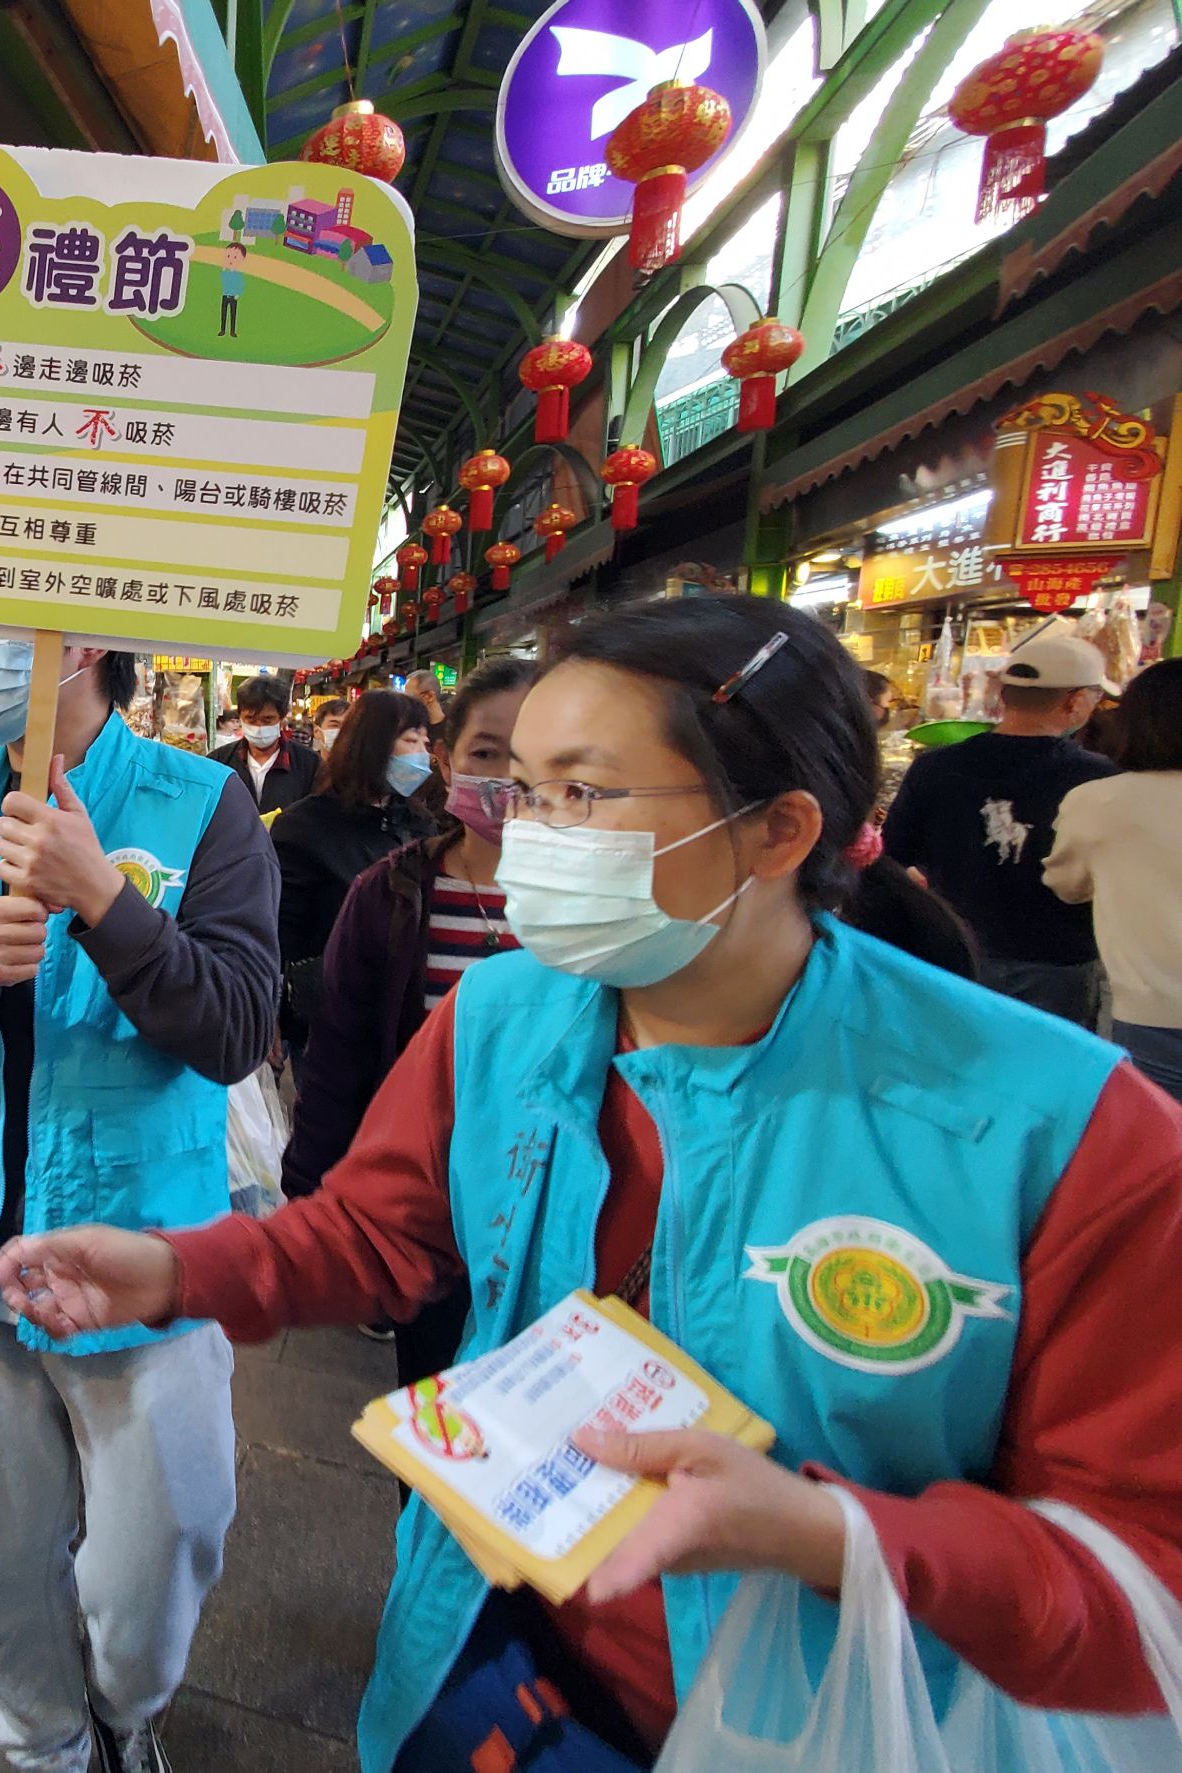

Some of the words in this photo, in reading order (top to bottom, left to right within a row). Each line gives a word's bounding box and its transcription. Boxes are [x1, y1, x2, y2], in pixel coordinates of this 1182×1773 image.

[546, 162, 612, 195] 品牌
[1030, 441, 1075, 543] 大進利商行
